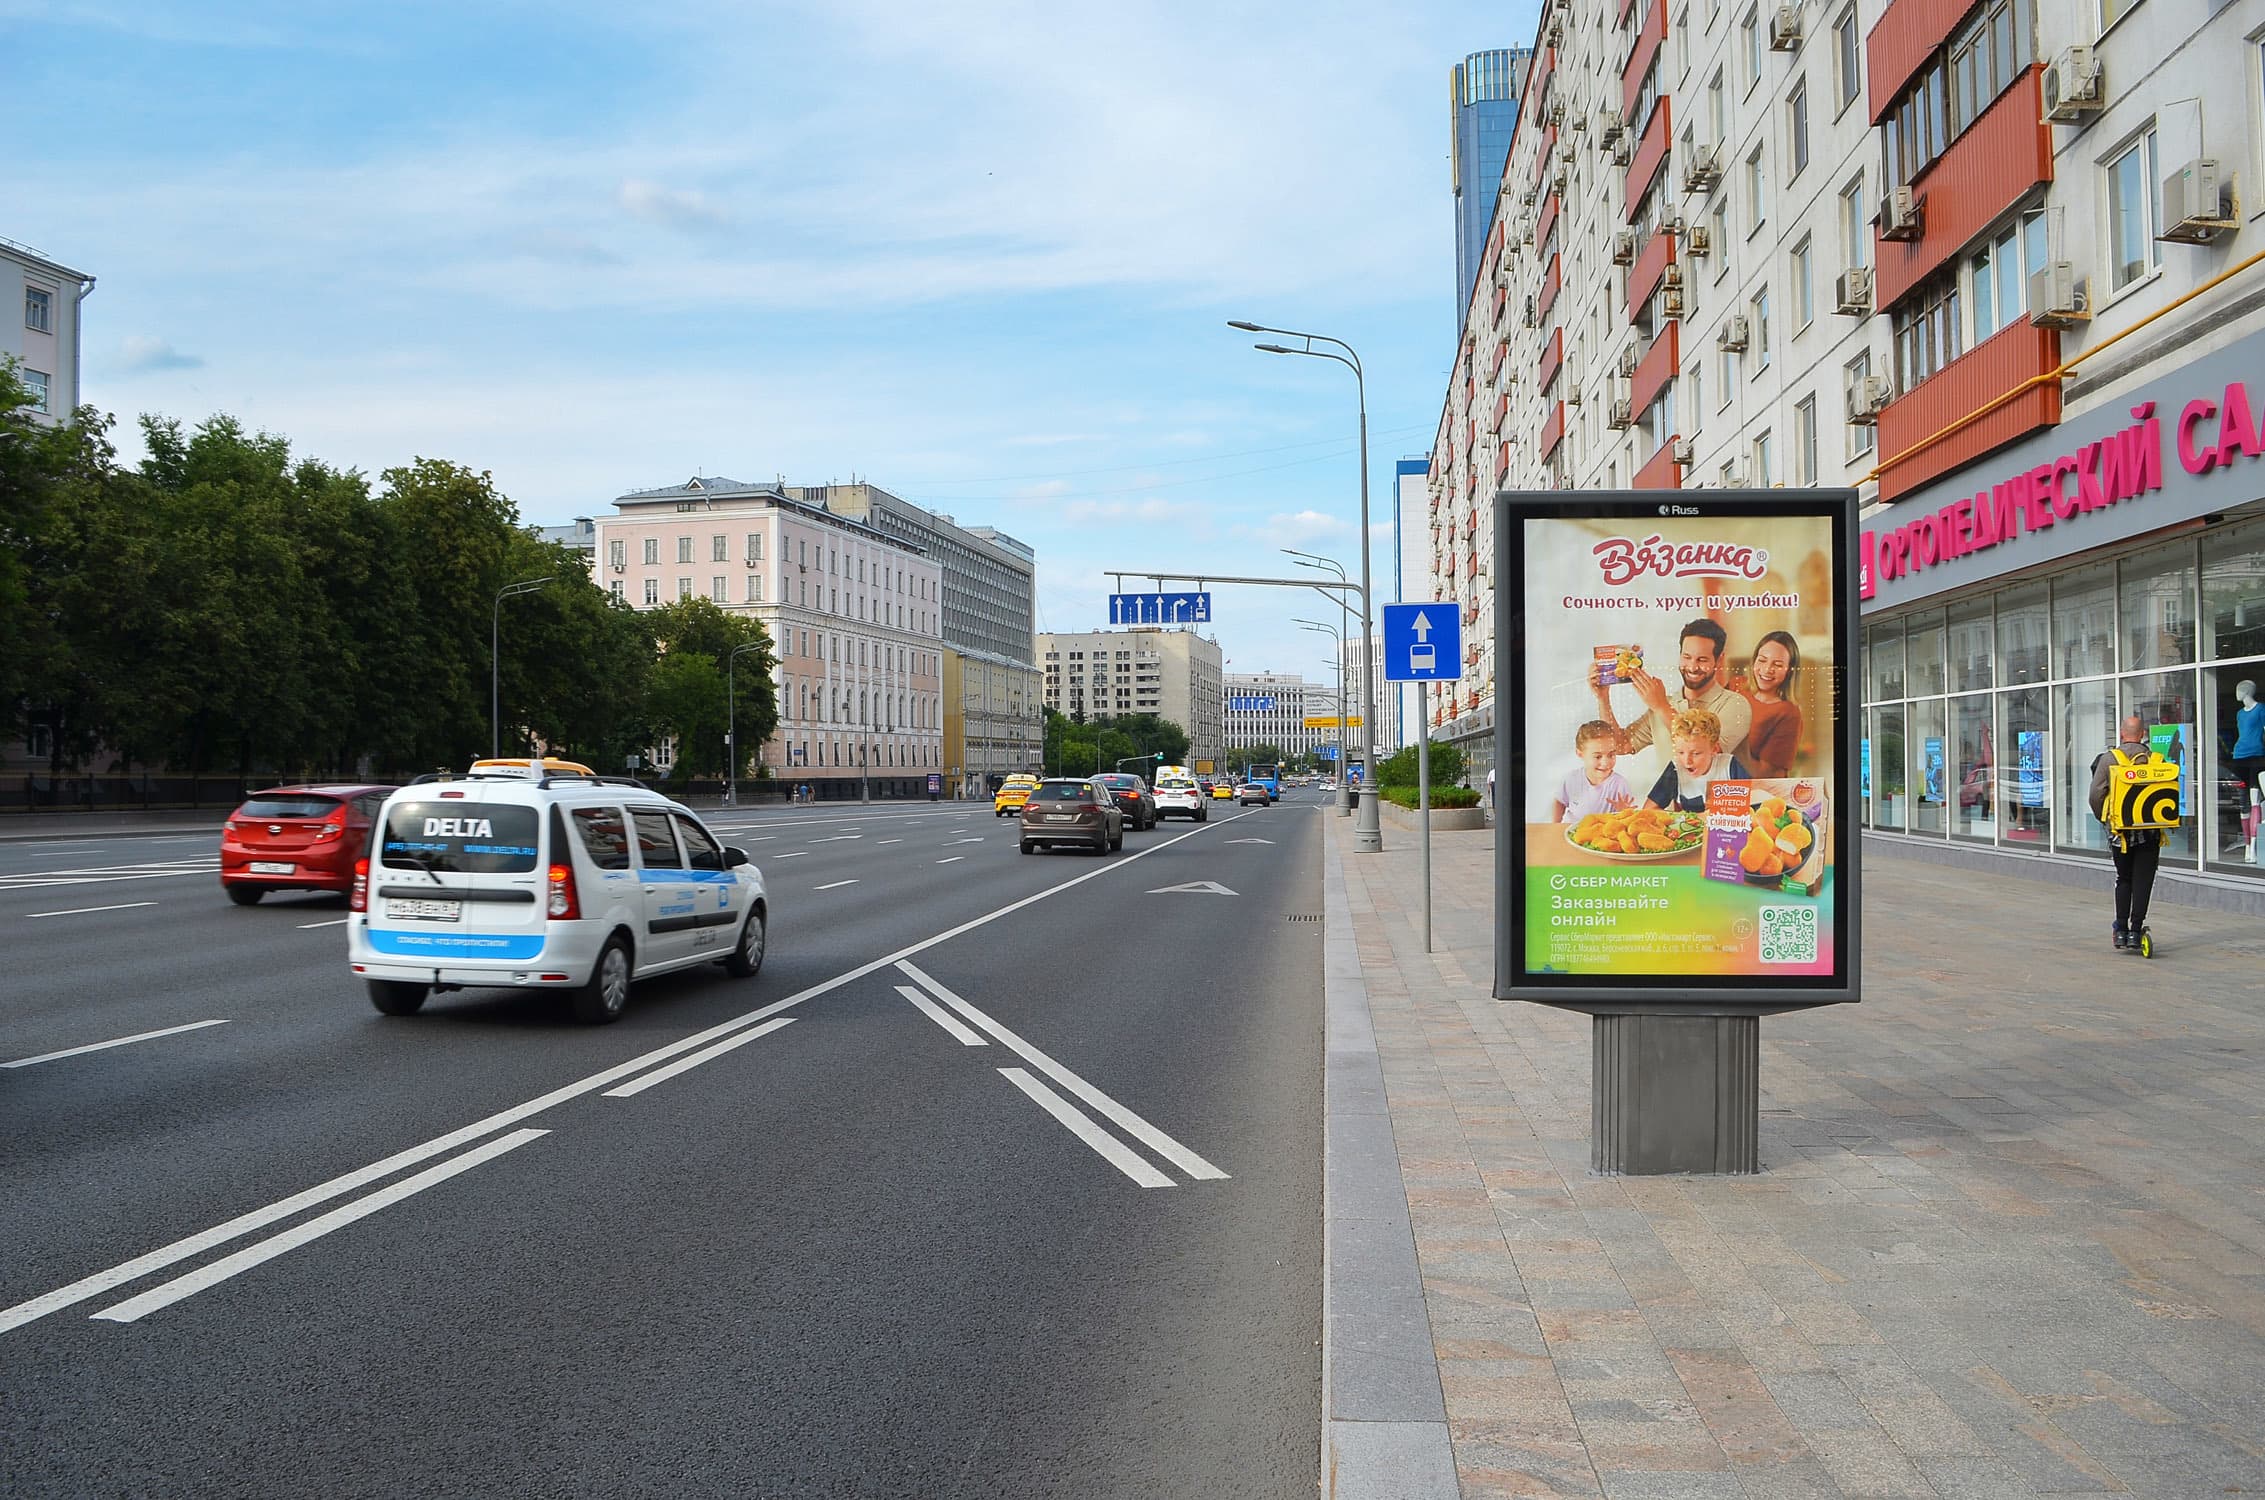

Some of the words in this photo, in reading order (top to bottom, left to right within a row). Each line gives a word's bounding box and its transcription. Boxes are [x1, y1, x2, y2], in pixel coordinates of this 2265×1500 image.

[1879, 401, 2162, 581] ОРТОПЕДИЧЕСКИЙ
[1671, 505, 1699, 515] Russ
[1593, 535, 1764, 586] Вязанка
[1563, 596, 1649, 609] Сочность,
[1656, 596, 1701, 611] хруст
[1709, 597, 1720, 609] и
[1725, 593, 1799, 612] улыбки!
[423, 817, 494, 838] DELTA
[1570, 877, 1607, 888] СБЕР
[1610, 876, 1669, 888] МАРКЕТ
[1551, 895, 1669, 909] Заказывайте
[1551, 912, 1617, 926] онлайн
